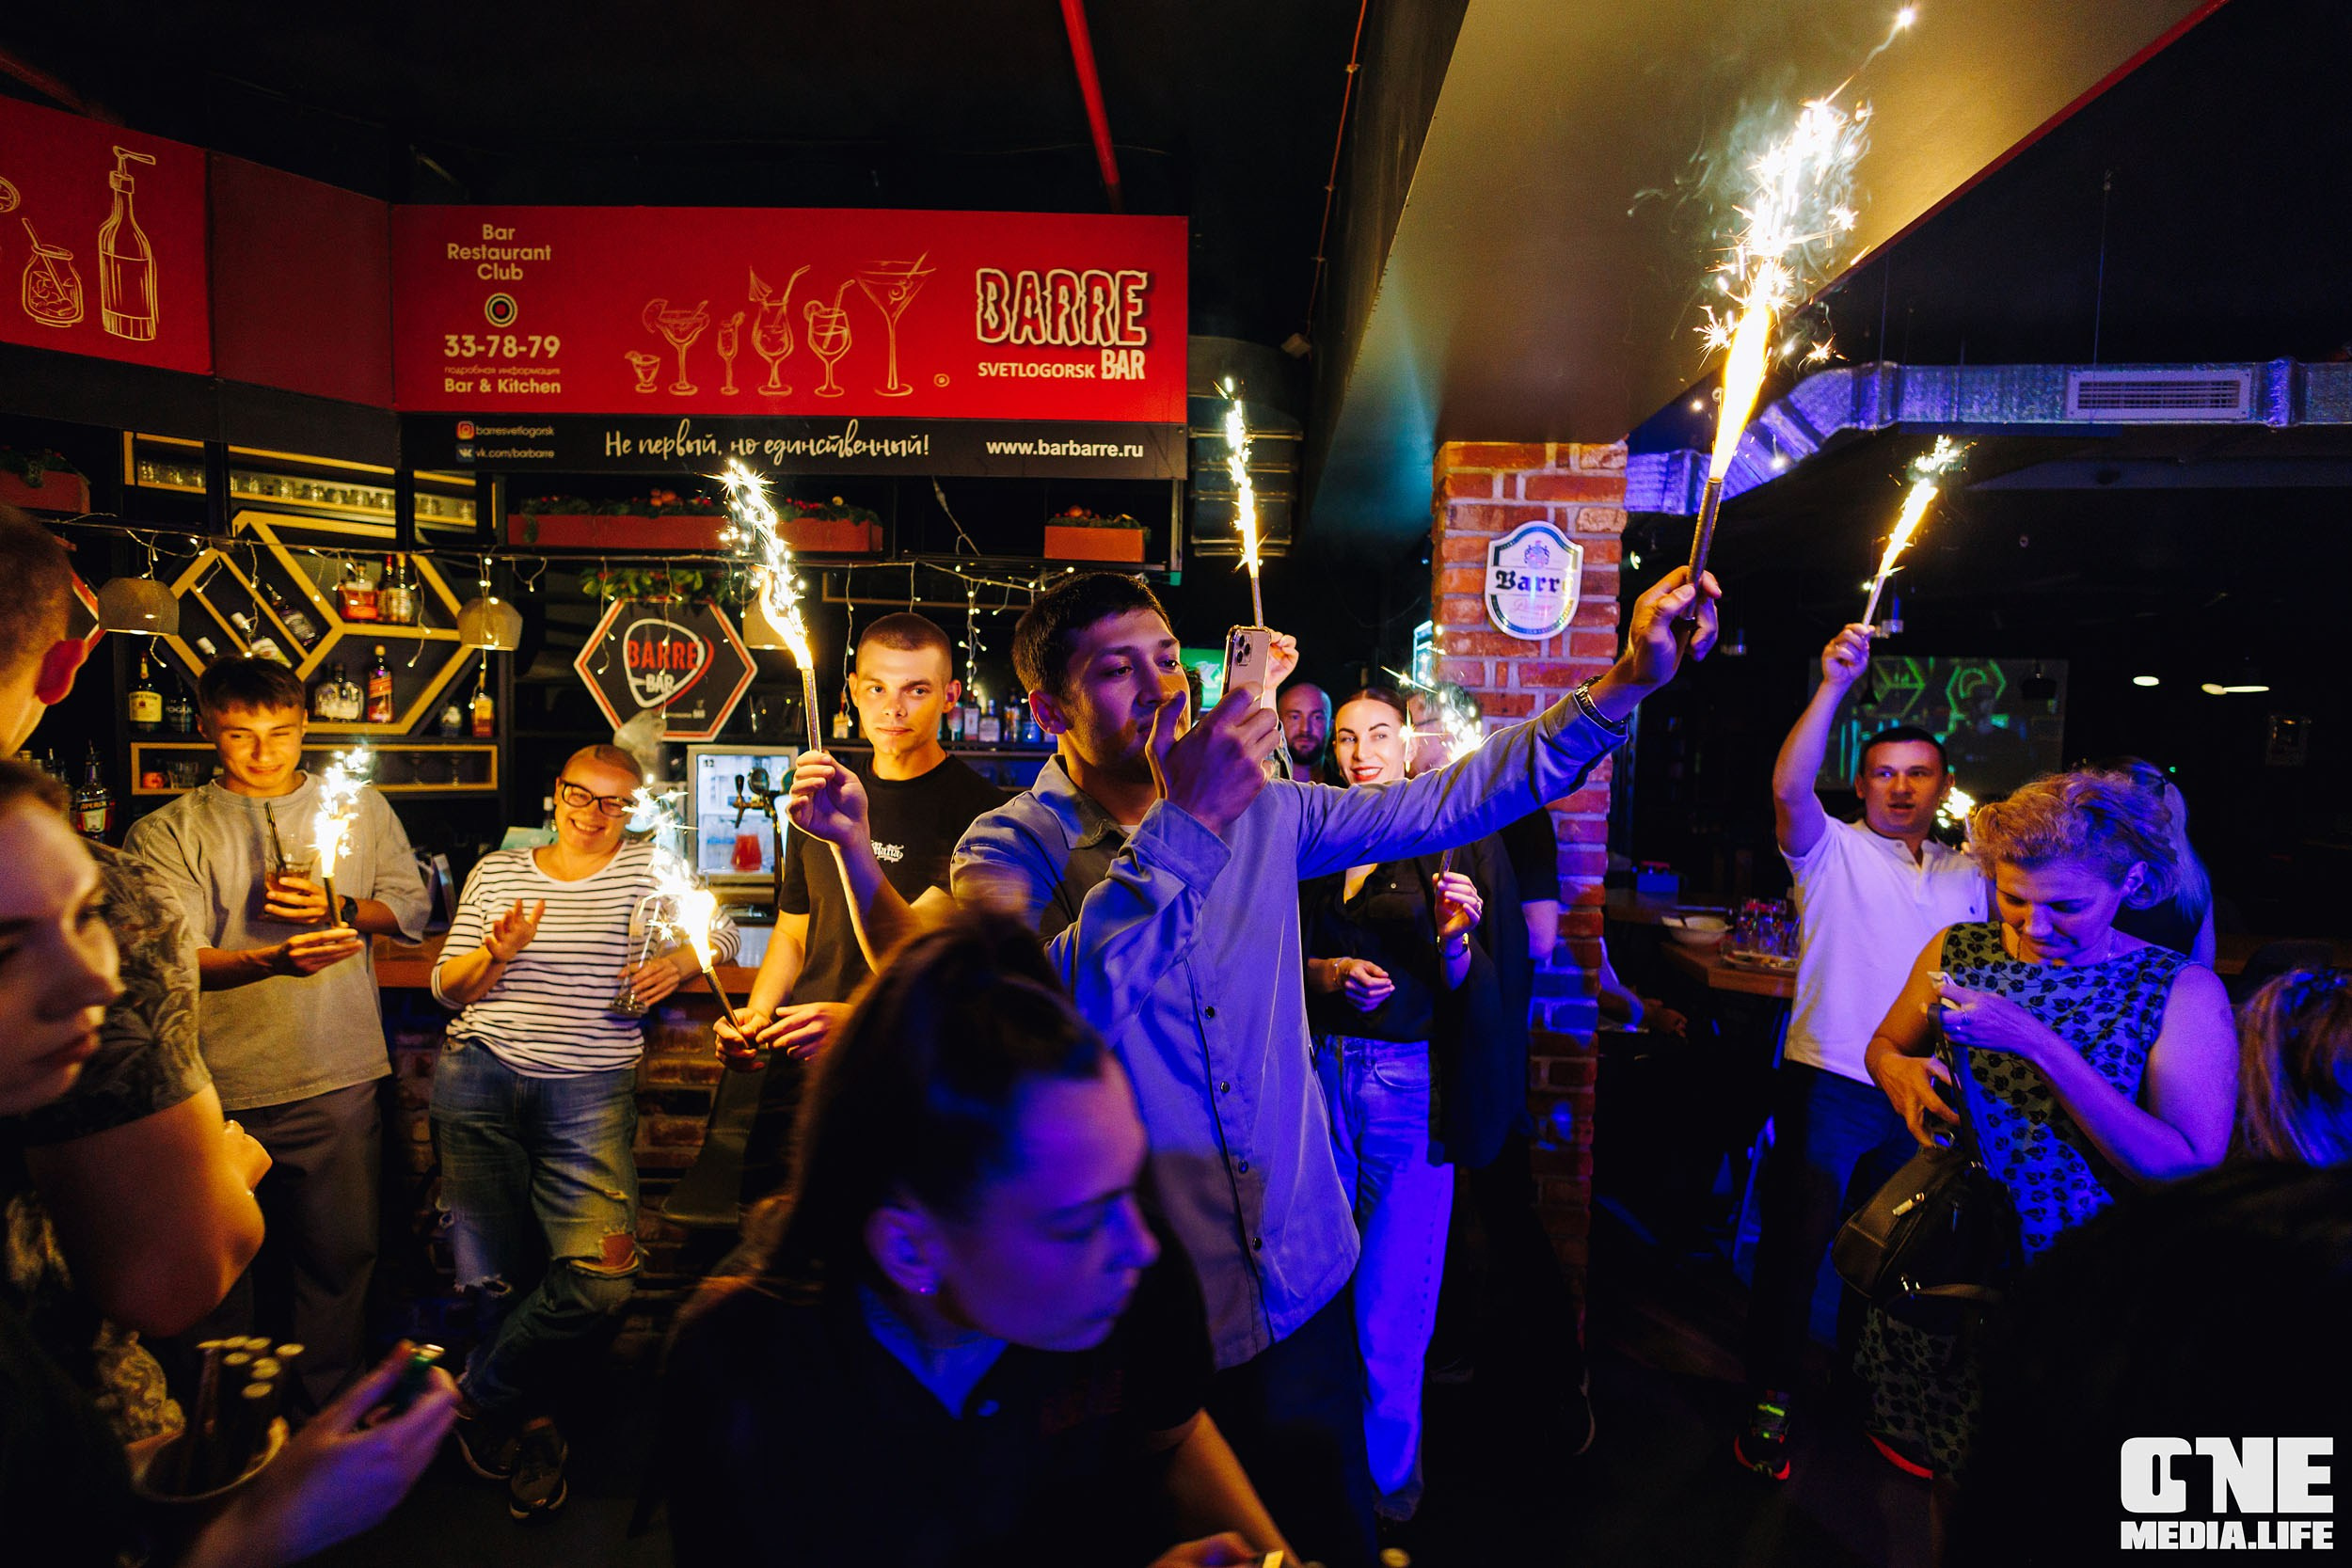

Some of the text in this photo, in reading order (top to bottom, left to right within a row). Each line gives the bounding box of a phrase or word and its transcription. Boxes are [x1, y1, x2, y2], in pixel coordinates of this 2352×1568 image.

[483, 224, 516, 240] Bar
[447, 243, 551, 261] Restaurant
[477, 262, 524, 280] Club
[976, 268, 1148, 346] BARRE
[444, 334, 561, 358] 33-78-79
[977, 349, 1146, 380] SVETLOGORSK BAR
[444, 377, 561, 394] Bar & Kitchen
[605, 419, 930, 466] Не первый, но единственный!
[986, 438, 1144, 457] www.barbarre.ru
[628, 640, 699, 670] BARRE
[645, 673, 675, 693] BAR
